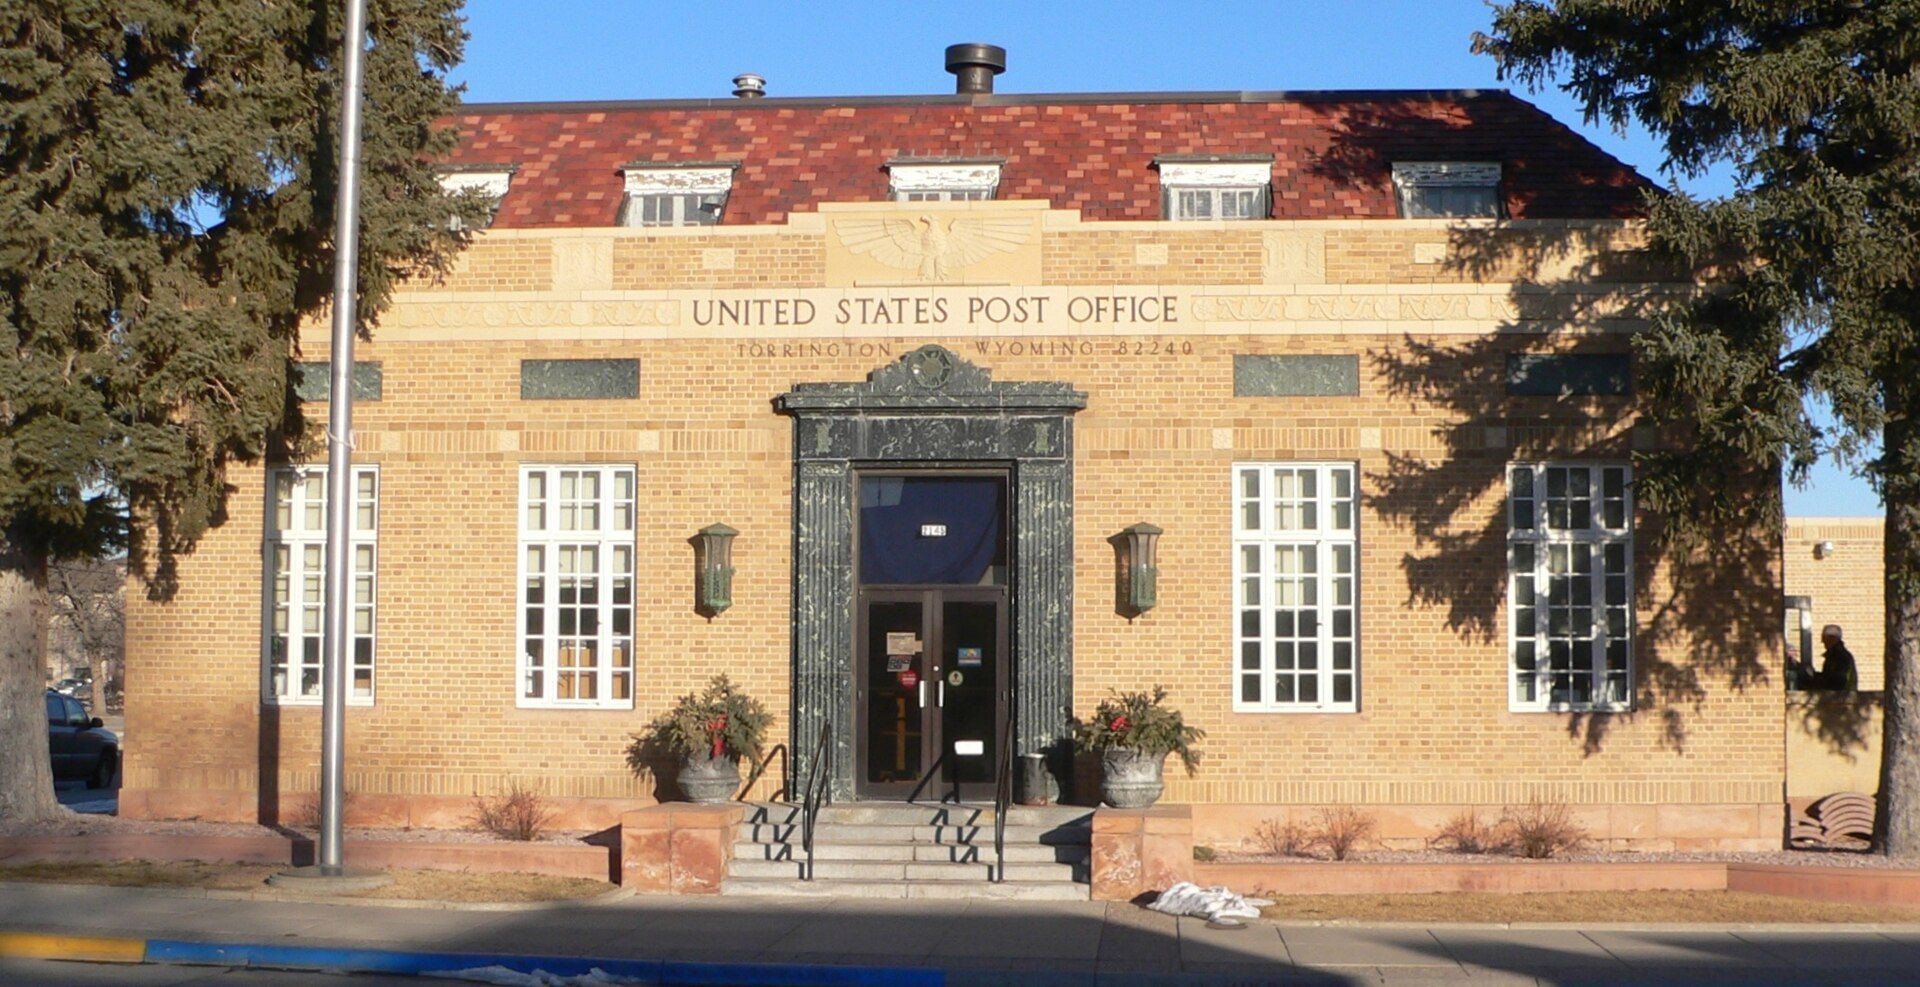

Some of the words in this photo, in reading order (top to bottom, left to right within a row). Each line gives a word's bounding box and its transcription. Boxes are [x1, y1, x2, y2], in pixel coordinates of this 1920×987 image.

[692, 299, 816, 326] UNITED
[835, 297, 948, 325] STATES
[968, 297, 1050, 324] POST
[1067, 296, 1178, 323] OFFICE
[737, 343, 891, 358] TORRINGTON
[975, 341, 1094, 356] WYOMING
[1119, 340, 1193, 356] 82240
